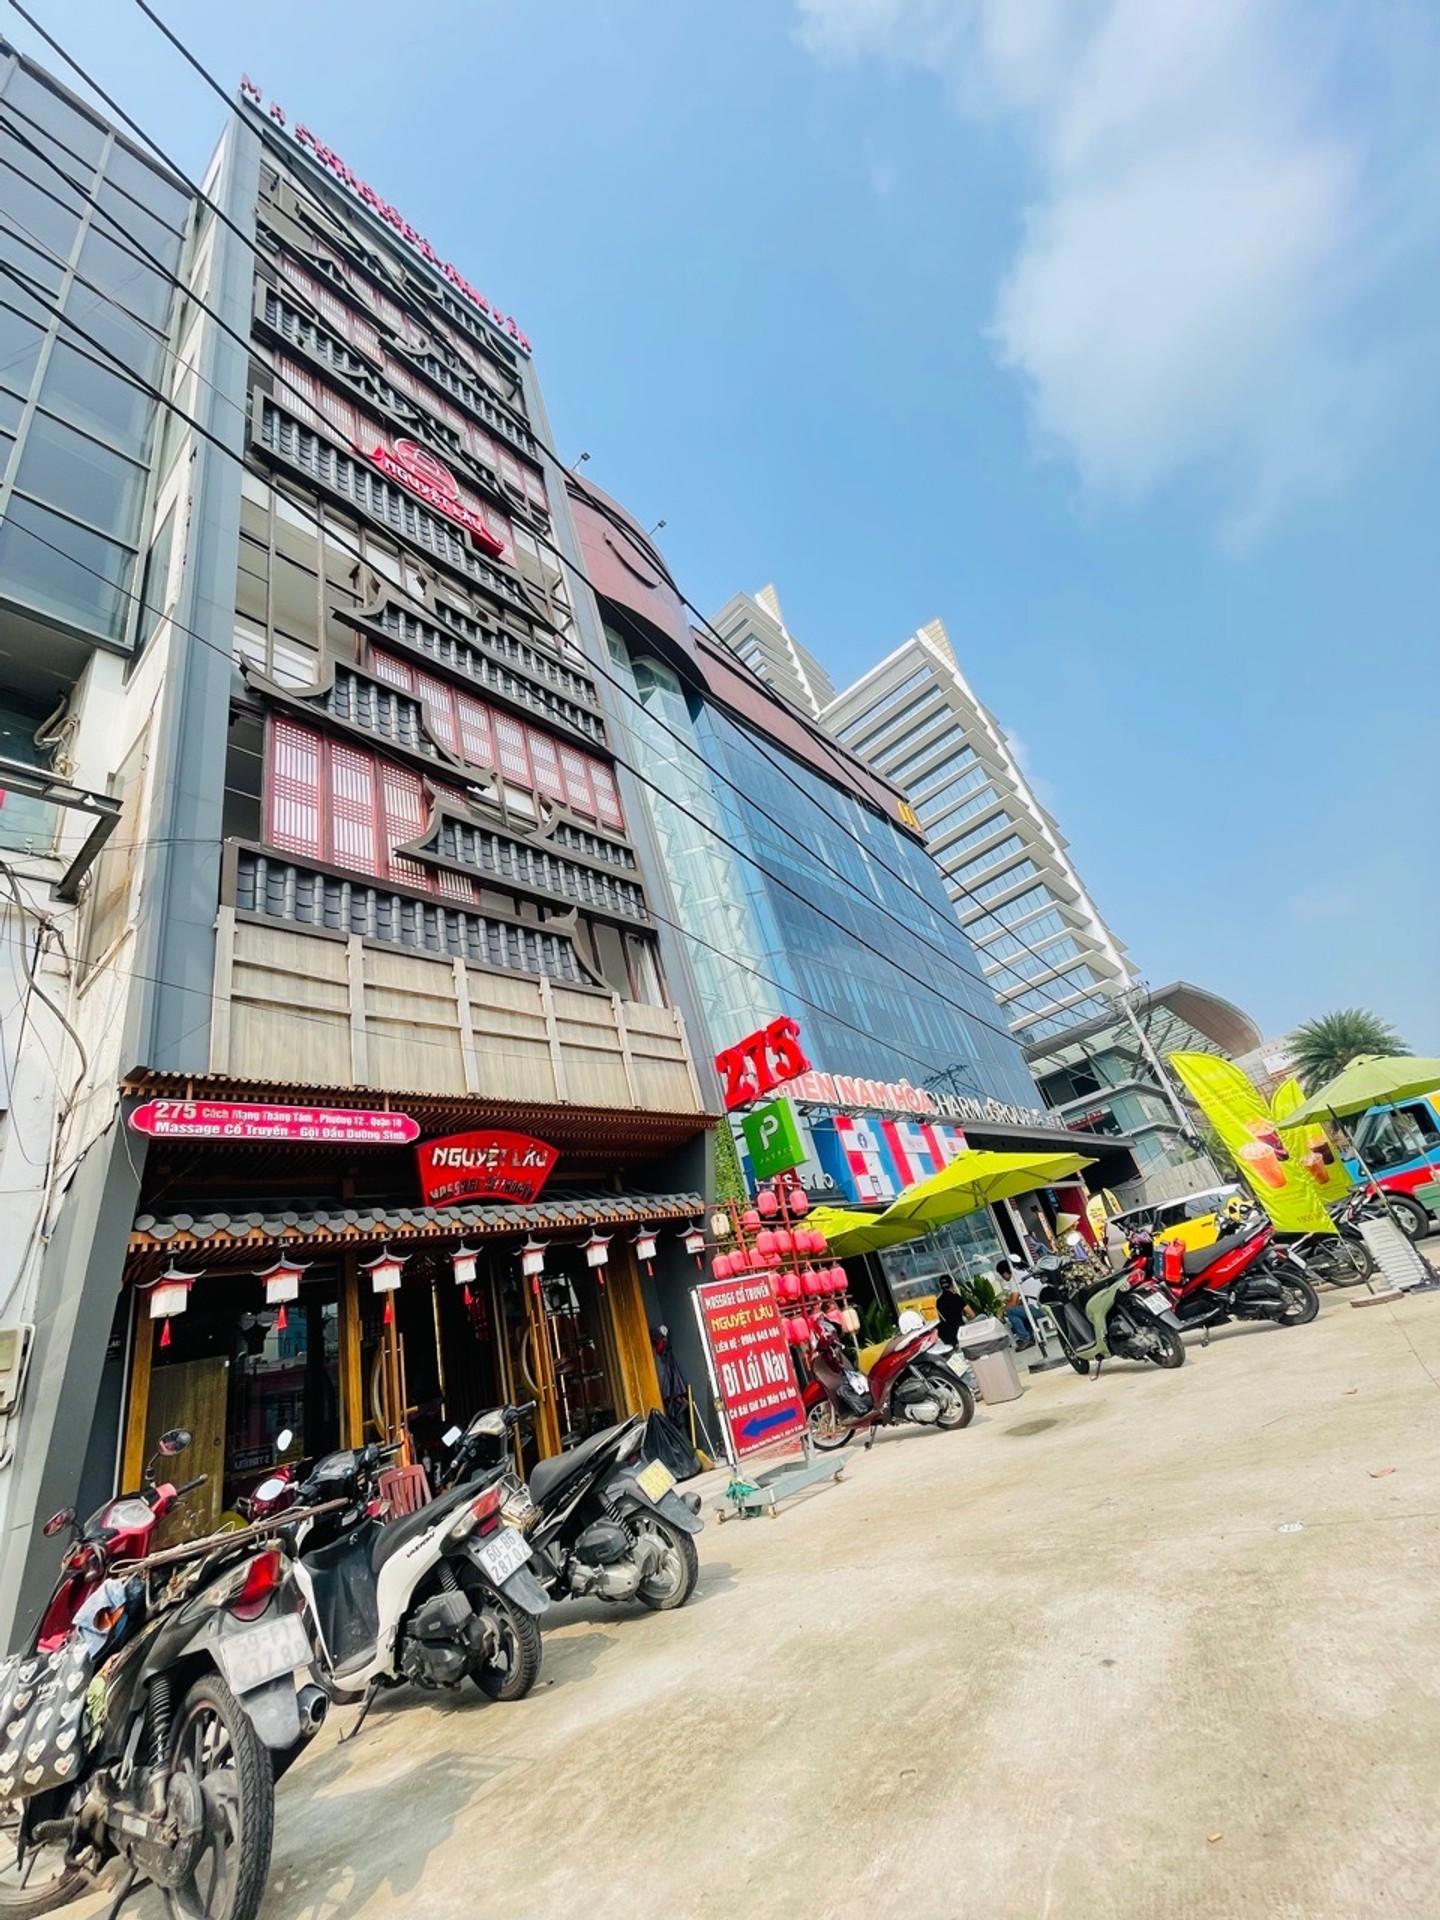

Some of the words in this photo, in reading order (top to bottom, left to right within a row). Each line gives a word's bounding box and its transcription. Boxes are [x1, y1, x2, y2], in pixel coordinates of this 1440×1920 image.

[715, 1016, 812, 1111] 275
[833, 1074, 888, 1109] NAM
[154, 1102, 197, 1119] 275
[202, 1107, 229, 1118] Cách
[232, 1109, 260, 1121] Mạng
[263, 1111, 291, 1122] Tháng
[926, 1091, 985, 1120] CHARM
[986, 1098, 1030, 1125] GROUP
[155, 1121, 220, 1136] Massage
[224, 1122, 243, 1135] Cổ
[244, 1124, 289, 1138] Truyền
[382, 1130, 406, 1140] Sinh
[704, 1291, 736, 1310] MASSAGE
[711, 1309, 752, 1332] NGUYỆT
[722, 1361, 741, 1397] Đi
[738, 1350, 763, 1392] Lối
[761, 1348, 789, 1384] Này
[486, 1531, 515, 1562] 60-B6
[491, 1542, 529, 1582] 287.02
